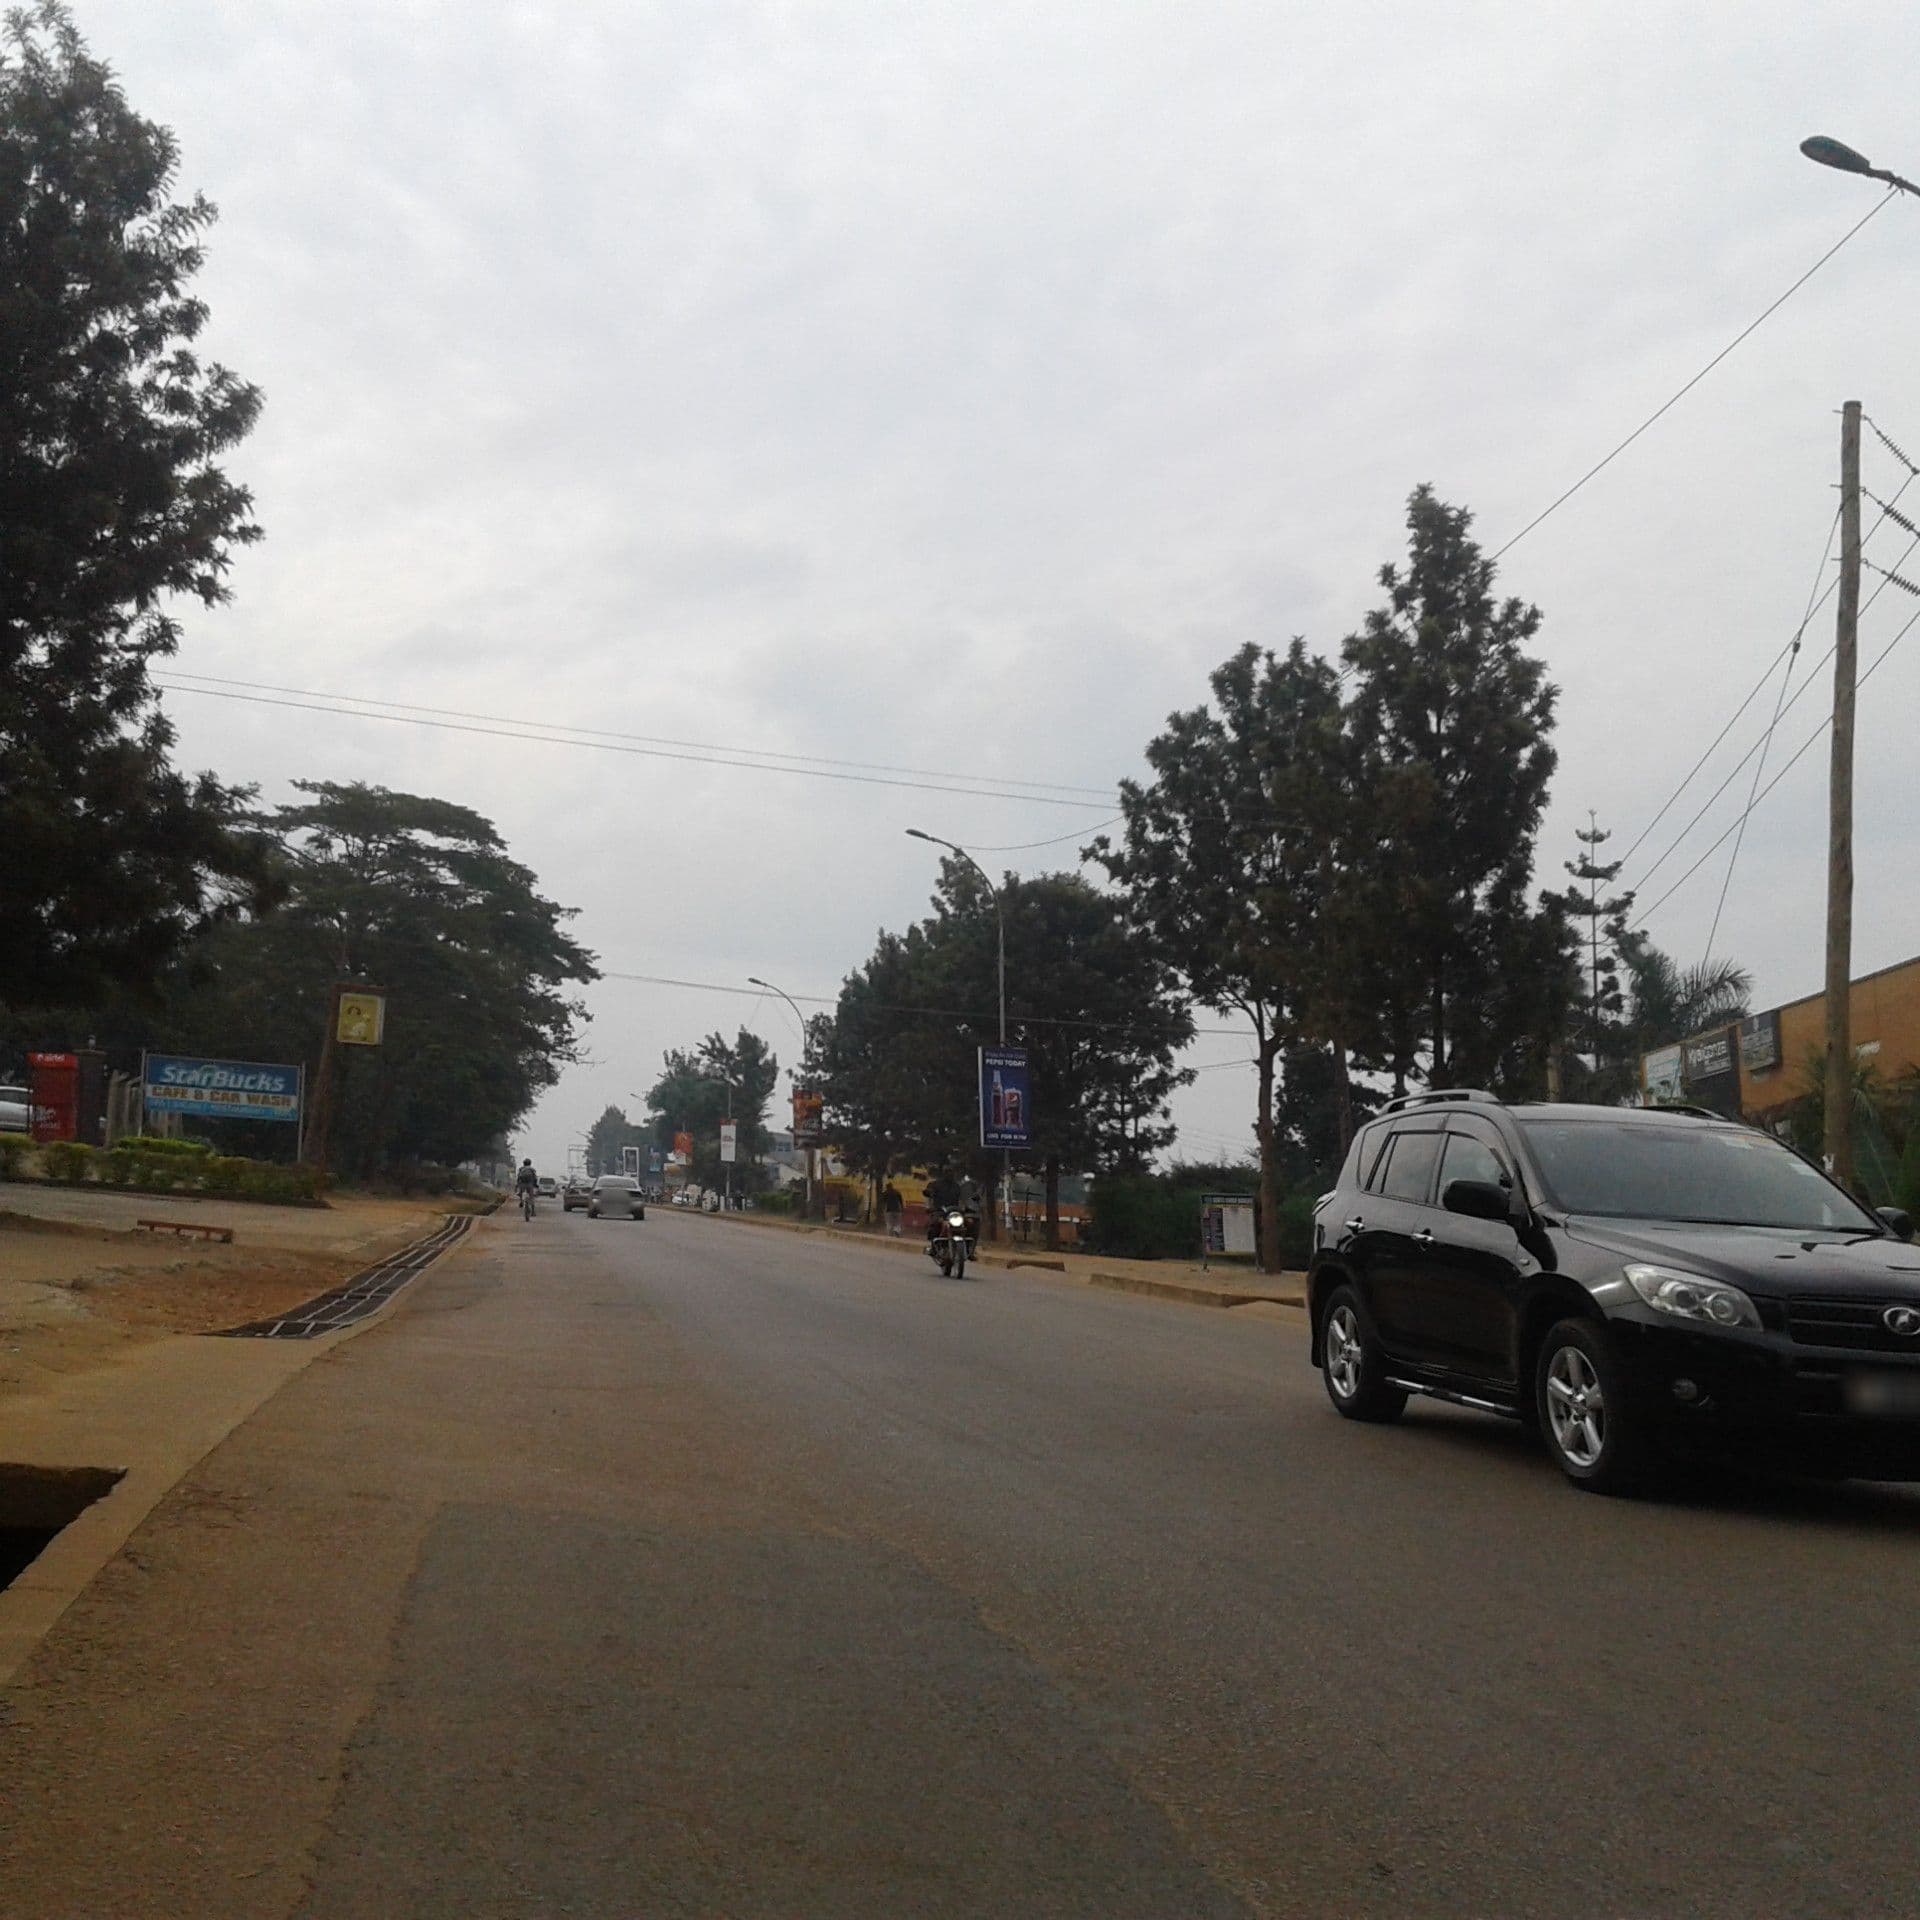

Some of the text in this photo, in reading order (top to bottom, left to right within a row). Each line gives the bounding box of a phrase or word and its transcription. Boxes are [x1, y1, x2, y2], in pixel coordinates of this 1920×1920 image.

[985, 1058, 1026, 1067] PEPSI TODAY
[210, 1090, 241, 1103] CAR
[247, 1093, 292, 1107] WASH
